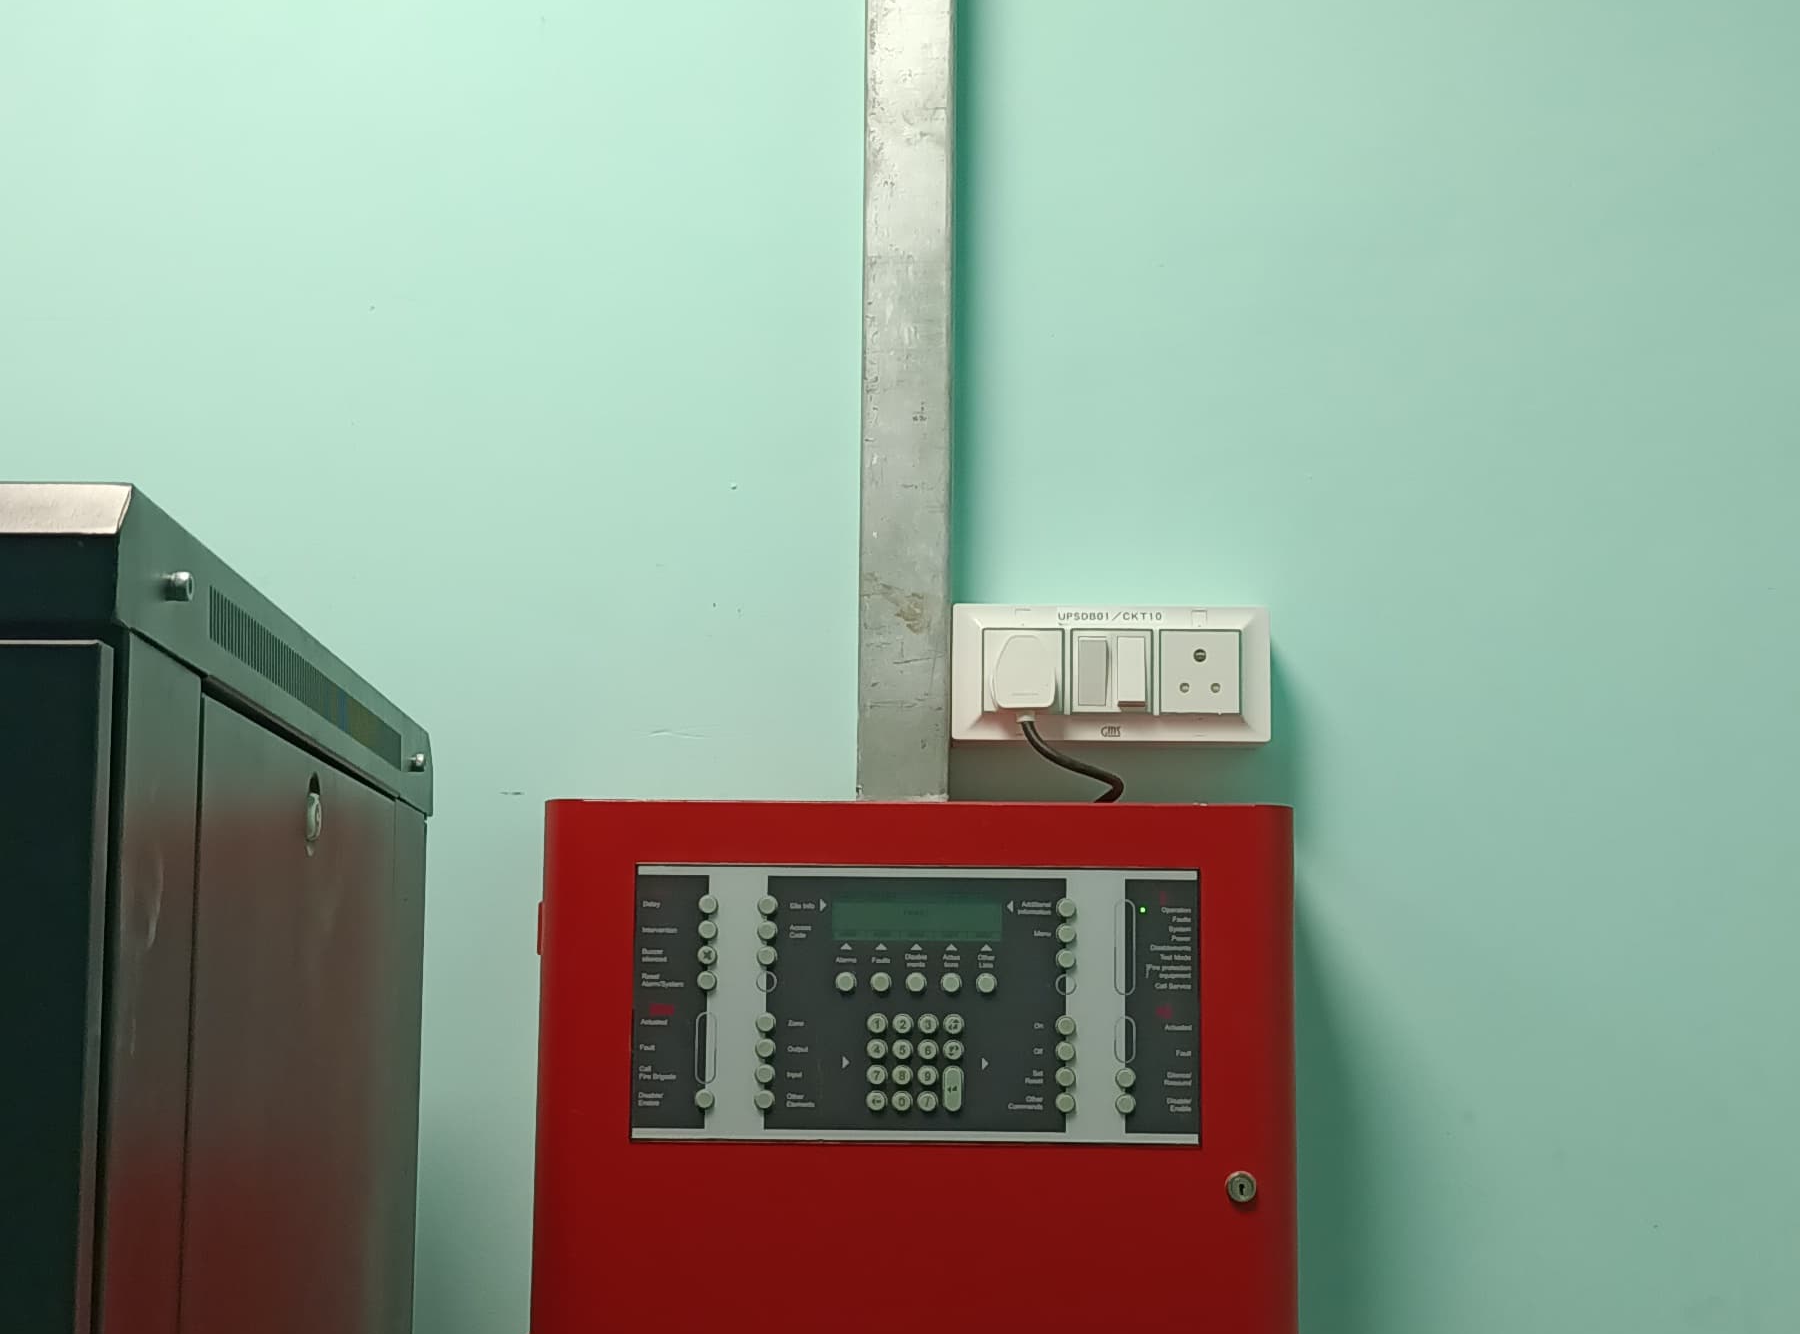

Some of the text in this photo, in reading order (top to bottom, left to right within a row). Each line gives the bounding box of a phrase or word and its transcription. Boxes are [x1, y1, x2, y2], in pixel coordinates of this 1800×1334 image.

[872, 1019, 881, 1030] 1
[898, 1019, 907, 1030] 2
[924, 1020, 932, 1030] 3
[872, 1045, 881, 1054] 4
[898, 1045, 906, 1055] 5
[924, 1046, 932, 1055] 6
[872, 1071, 881, 1080] 7
[898, 1071, 906, 1081] 8
[924, 1071, 932, 1081] 9
[898, 1097, 905, 1107] 0
